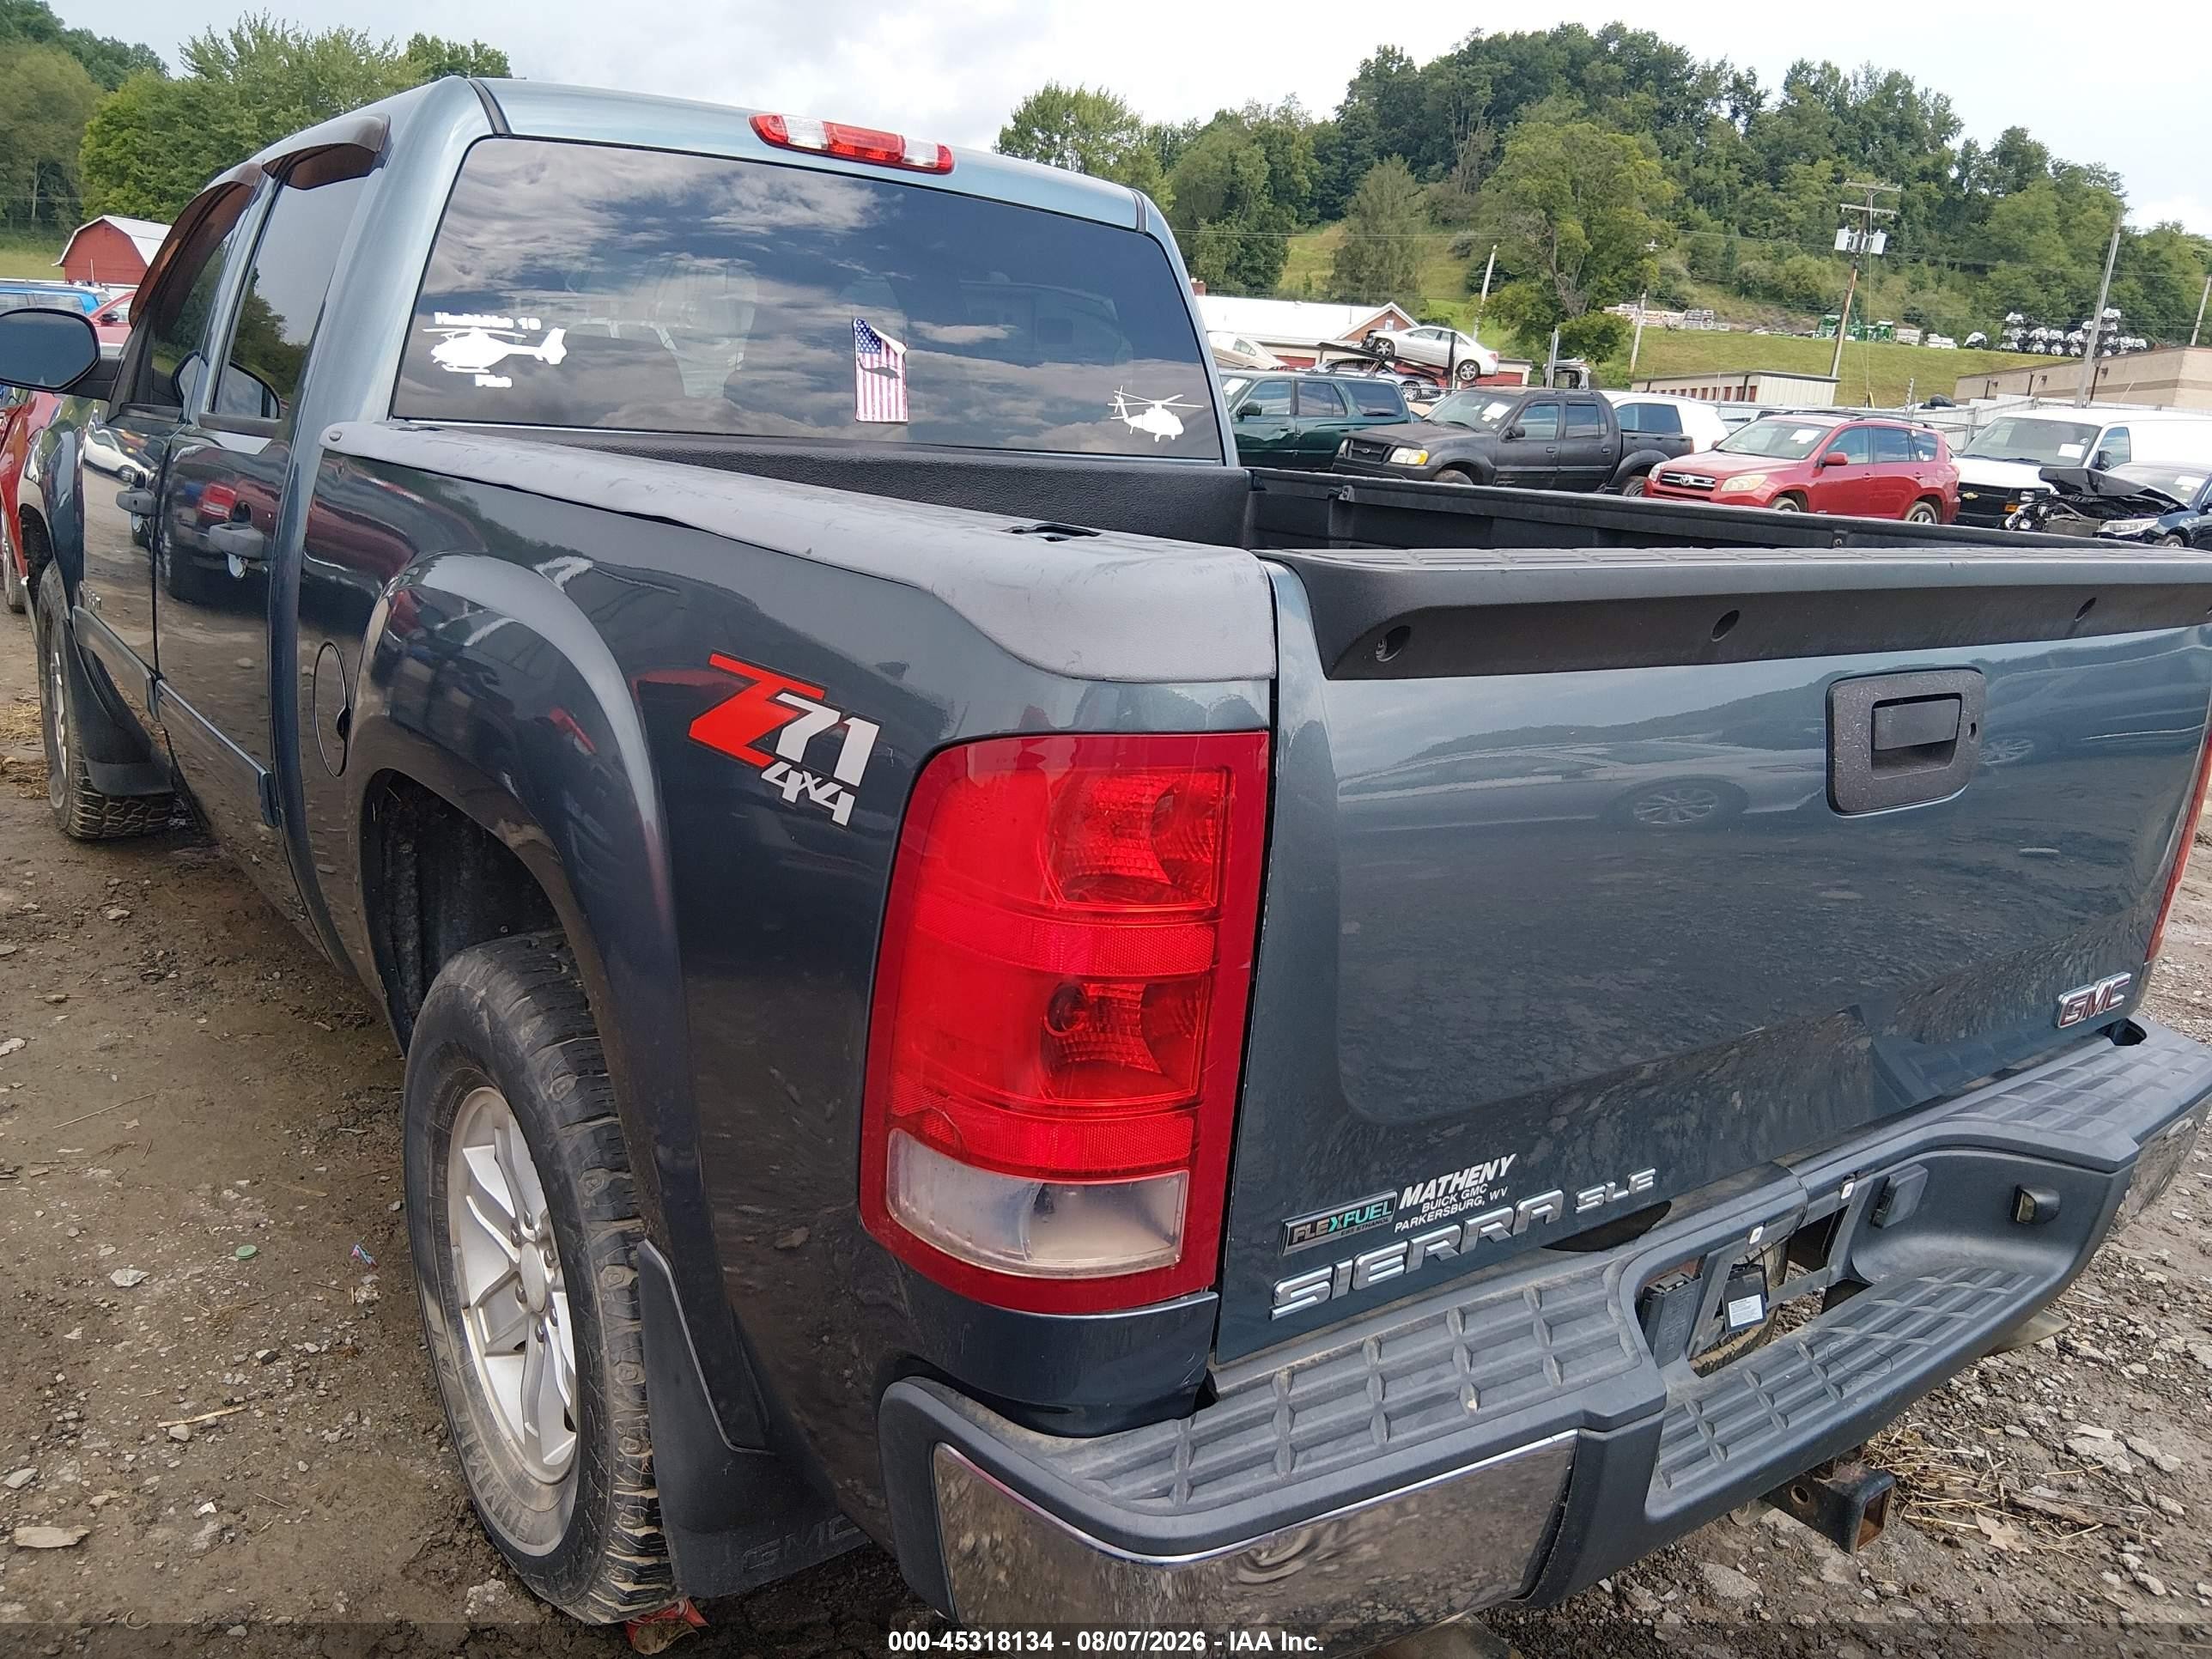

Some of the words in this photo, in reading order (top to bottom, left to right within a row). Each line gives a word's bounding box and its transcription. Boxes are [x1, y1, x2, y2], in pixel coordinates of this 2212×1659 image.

[689, 653, 880, 787] Z71
[2057, 971, 2131, 1028] GMC
[1395, 1194, 1486, 1233] PARKERSBURG,
[1490, 1186, 1509, 1201] WV
[1399, 1153, 1516, 1210] MATHENY
[1421, 1193, 1458, 1213] BUICK
[1461, 1183, 1488, 1200] GMC
[1575, 1167, 1656, 1213] SLE
[1292, 1200, 1392, 1243] FLEXFUEL
[1269, 1188, 1565, 1320] SIERRA
[742, 1514, 861, 1573] GMC
